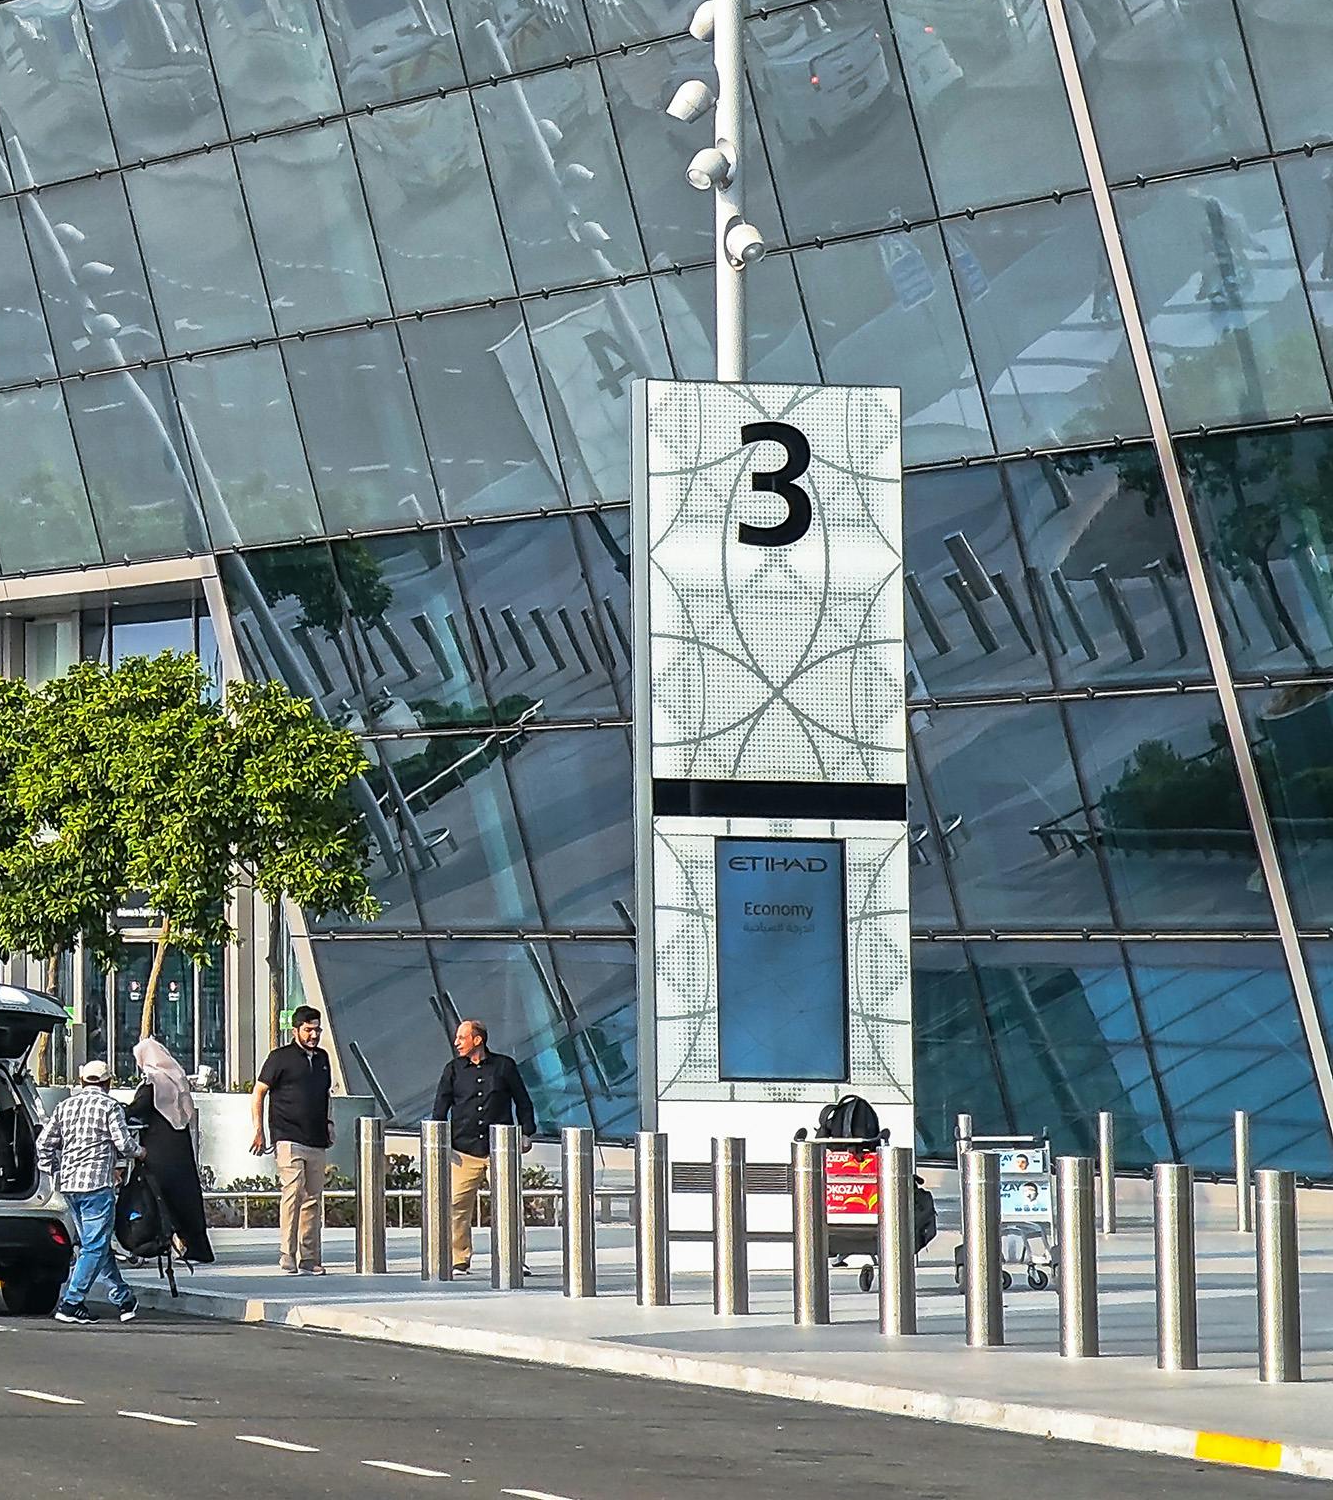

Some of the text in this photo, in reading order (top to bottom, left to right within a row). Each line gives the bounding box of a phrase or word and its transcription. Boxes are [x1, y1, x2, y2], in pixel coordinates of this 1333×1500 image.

[738, 422, 812, 547] 3
[729, 857, 828, 872] ETIHAD
[744, 902, 813, 920] Economy
